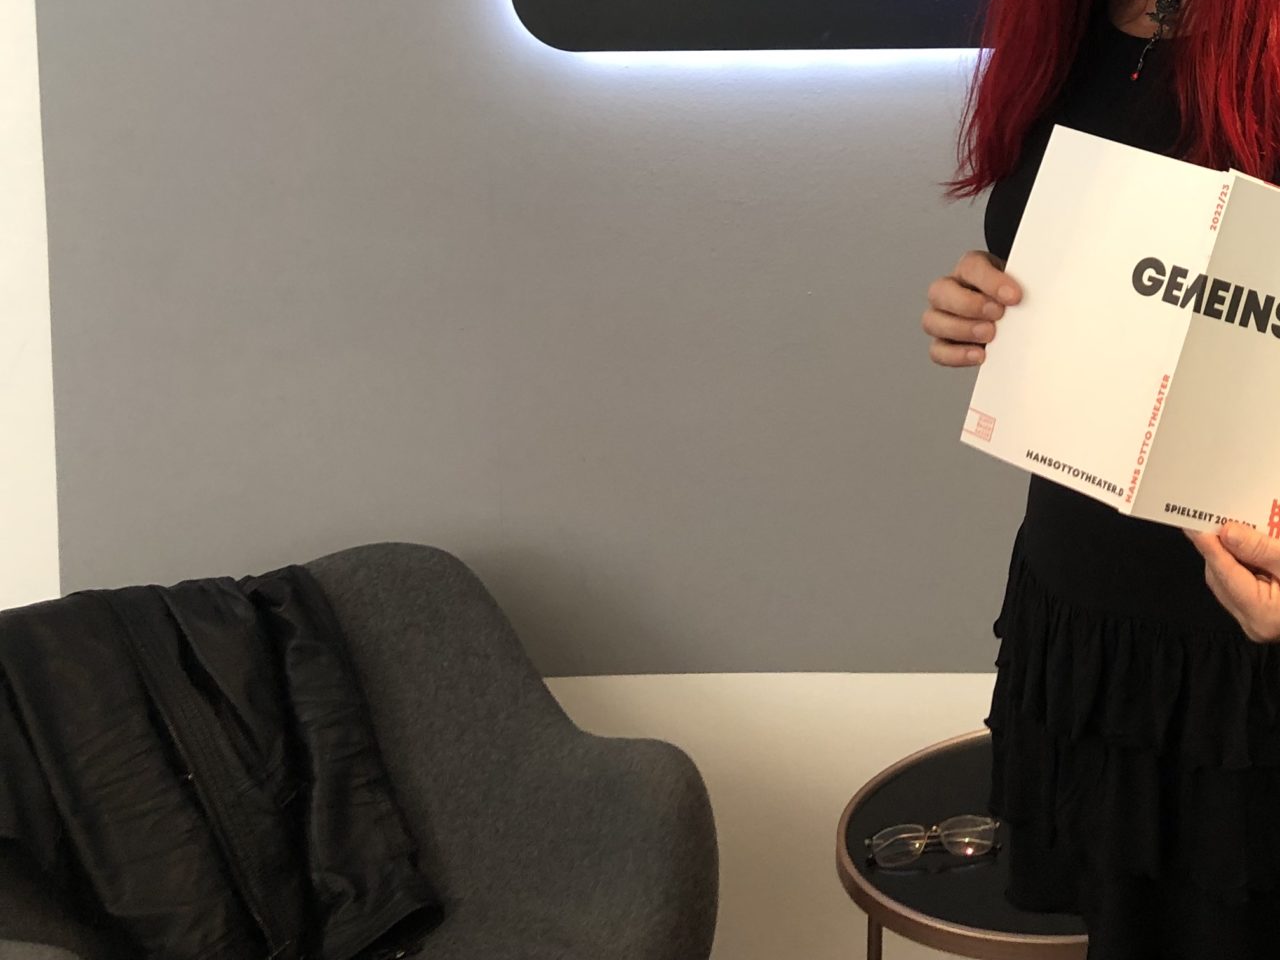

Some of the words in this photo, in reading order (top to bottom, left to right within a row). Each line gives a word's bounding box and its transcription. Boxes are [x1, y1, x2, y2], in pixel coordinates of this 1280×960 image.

[1210, 184, 1230, 231] 2022/23
[1125, 468, 1141, 503] HANS
[1137, 431, 1152, 465] OTTO
[1148, 374, 1170, 428] THEATER
[1026, 449, 1124, 497] HANSOTTOTHEATER.D
[1164, 503, 1214, 523] SPIELZEIT
